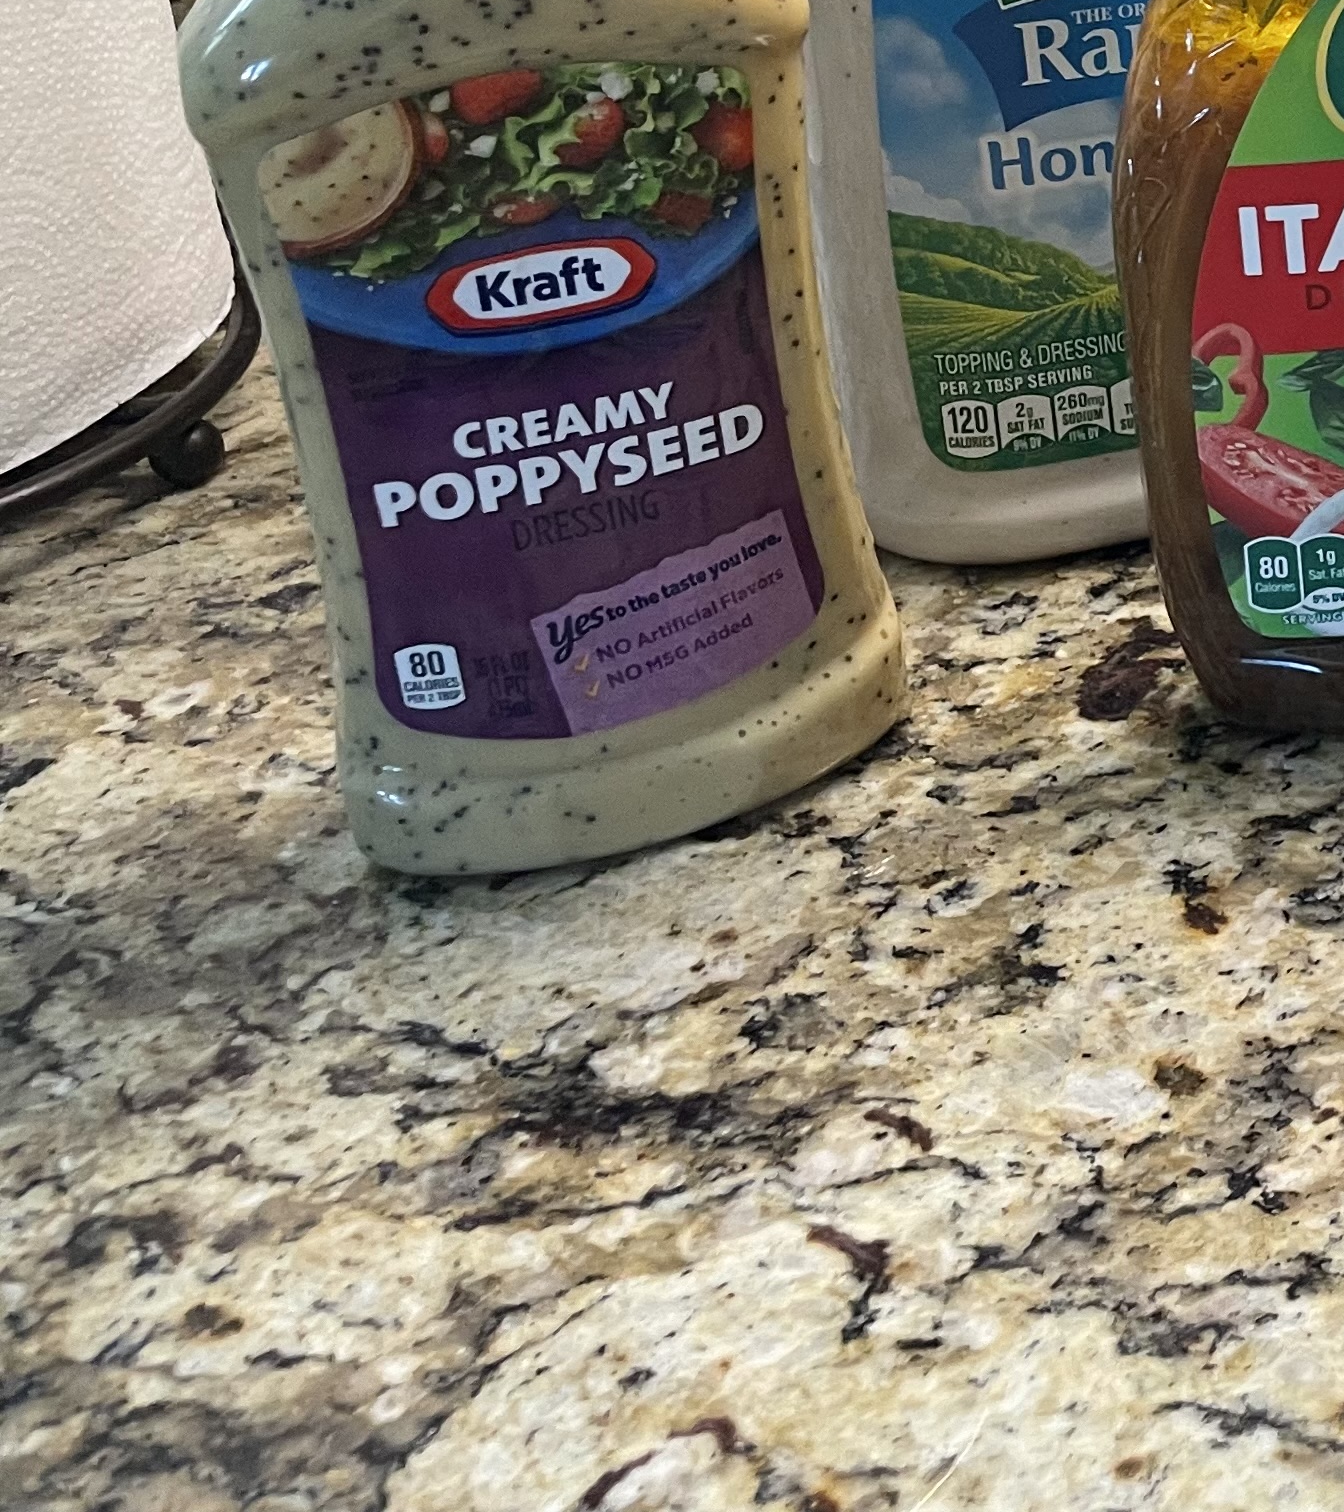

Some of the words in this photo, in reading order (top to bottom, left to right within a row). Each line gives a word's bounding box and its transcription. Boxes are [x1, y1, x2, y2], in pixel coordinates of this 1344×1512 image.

[1070, 6, 1113, 26] THE
[475, 255, 606, 313] Kraft
[933, 349, 1014, 376] TOPPING
[1018, 347, 1035, 369] &
[1036, 331, 1127, 367] DRESSING
[939, 379, 970, 396] PER
[972, 379, 982, 394] 2
[984, 373, 1024, 394] TBSP
[1026, 364, 1094, 390] SERVING
[453, 381, 674, 460] CREAMY
[946, 406, 989, 435] 120
[1028, 417, 1046, 432] FAT
[1062, 407, 1104, 426] SODIUM
[948, 436, 996, 449] CALORIES
[373, 403, 765, 529] POPPYSEED
[511, 489, 662, 552] DRESSING
[1259, 555, 1289, 580] 80
[1316, 546, 1336, 567] 1g
[606, 604, 627, 622] to
[628, 589, 661, 615] the
[661, 567, 707, 598] taste
[707, 552, 743, 581] you
[741, 534, 784, 563] love.
[1254, 579, 1297, 594] Calories
[596, 636, 632, 665] NO
[637, 600, 719, 648] Artificial
[719, 567, 785, 610] Flavors
[1282, 611, 1344, 626] SERVING
[409, 651, 446, 678] 80
[606, 662, 643, 689] NO
[647, 645, 691, 674] MSG
[693, 612, 754, 654] Added
[404, 676, 460, 693] CALORIES
